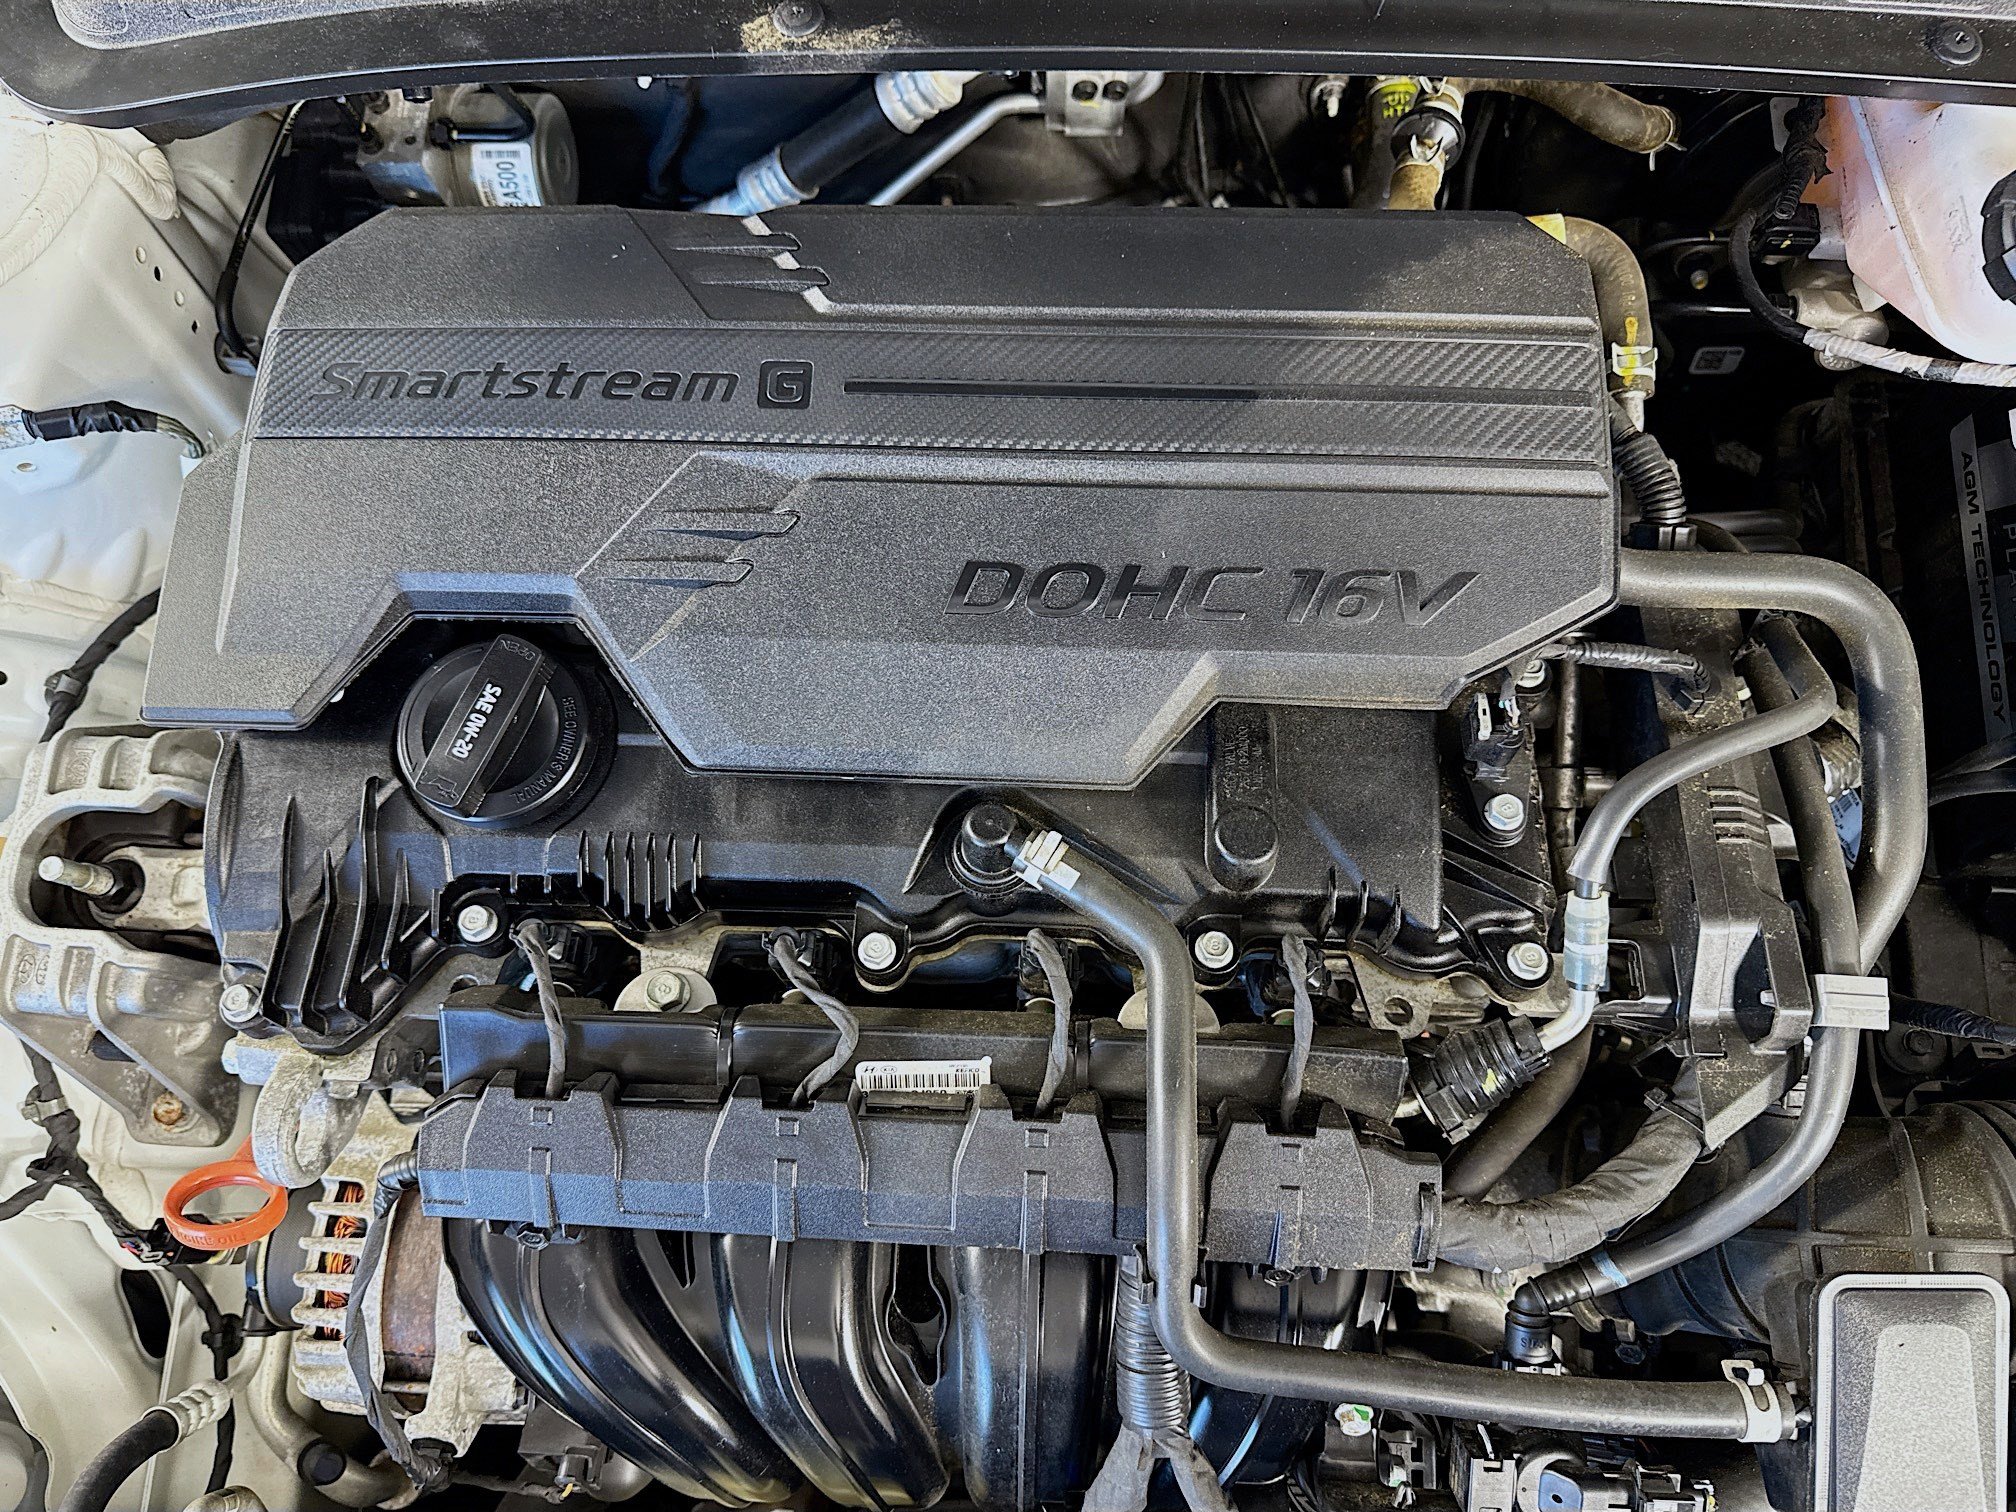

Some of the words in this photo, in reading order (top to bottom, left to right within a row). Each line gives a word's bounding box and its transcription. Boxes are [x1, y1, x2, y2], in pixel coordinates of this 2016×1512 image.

[308, 360, 741, 402] Smartstream
[762, 364, 809, 405] G
[943, 559, 1266, 622] DOHC
[1286, 568, 1482, 627] 16V
[1960, 451, 1980, 515] AGM
[1971, 523, 2006, 725] TECHNOLOGY
[474, 683, 502, 714] SAE
[562, 697, 578, 718] SEE
[451, 713, 487, 758] 0W-20
[550, 720, 577, 771] OWNER'S
[508, 769, 557, 803] MANUAL
